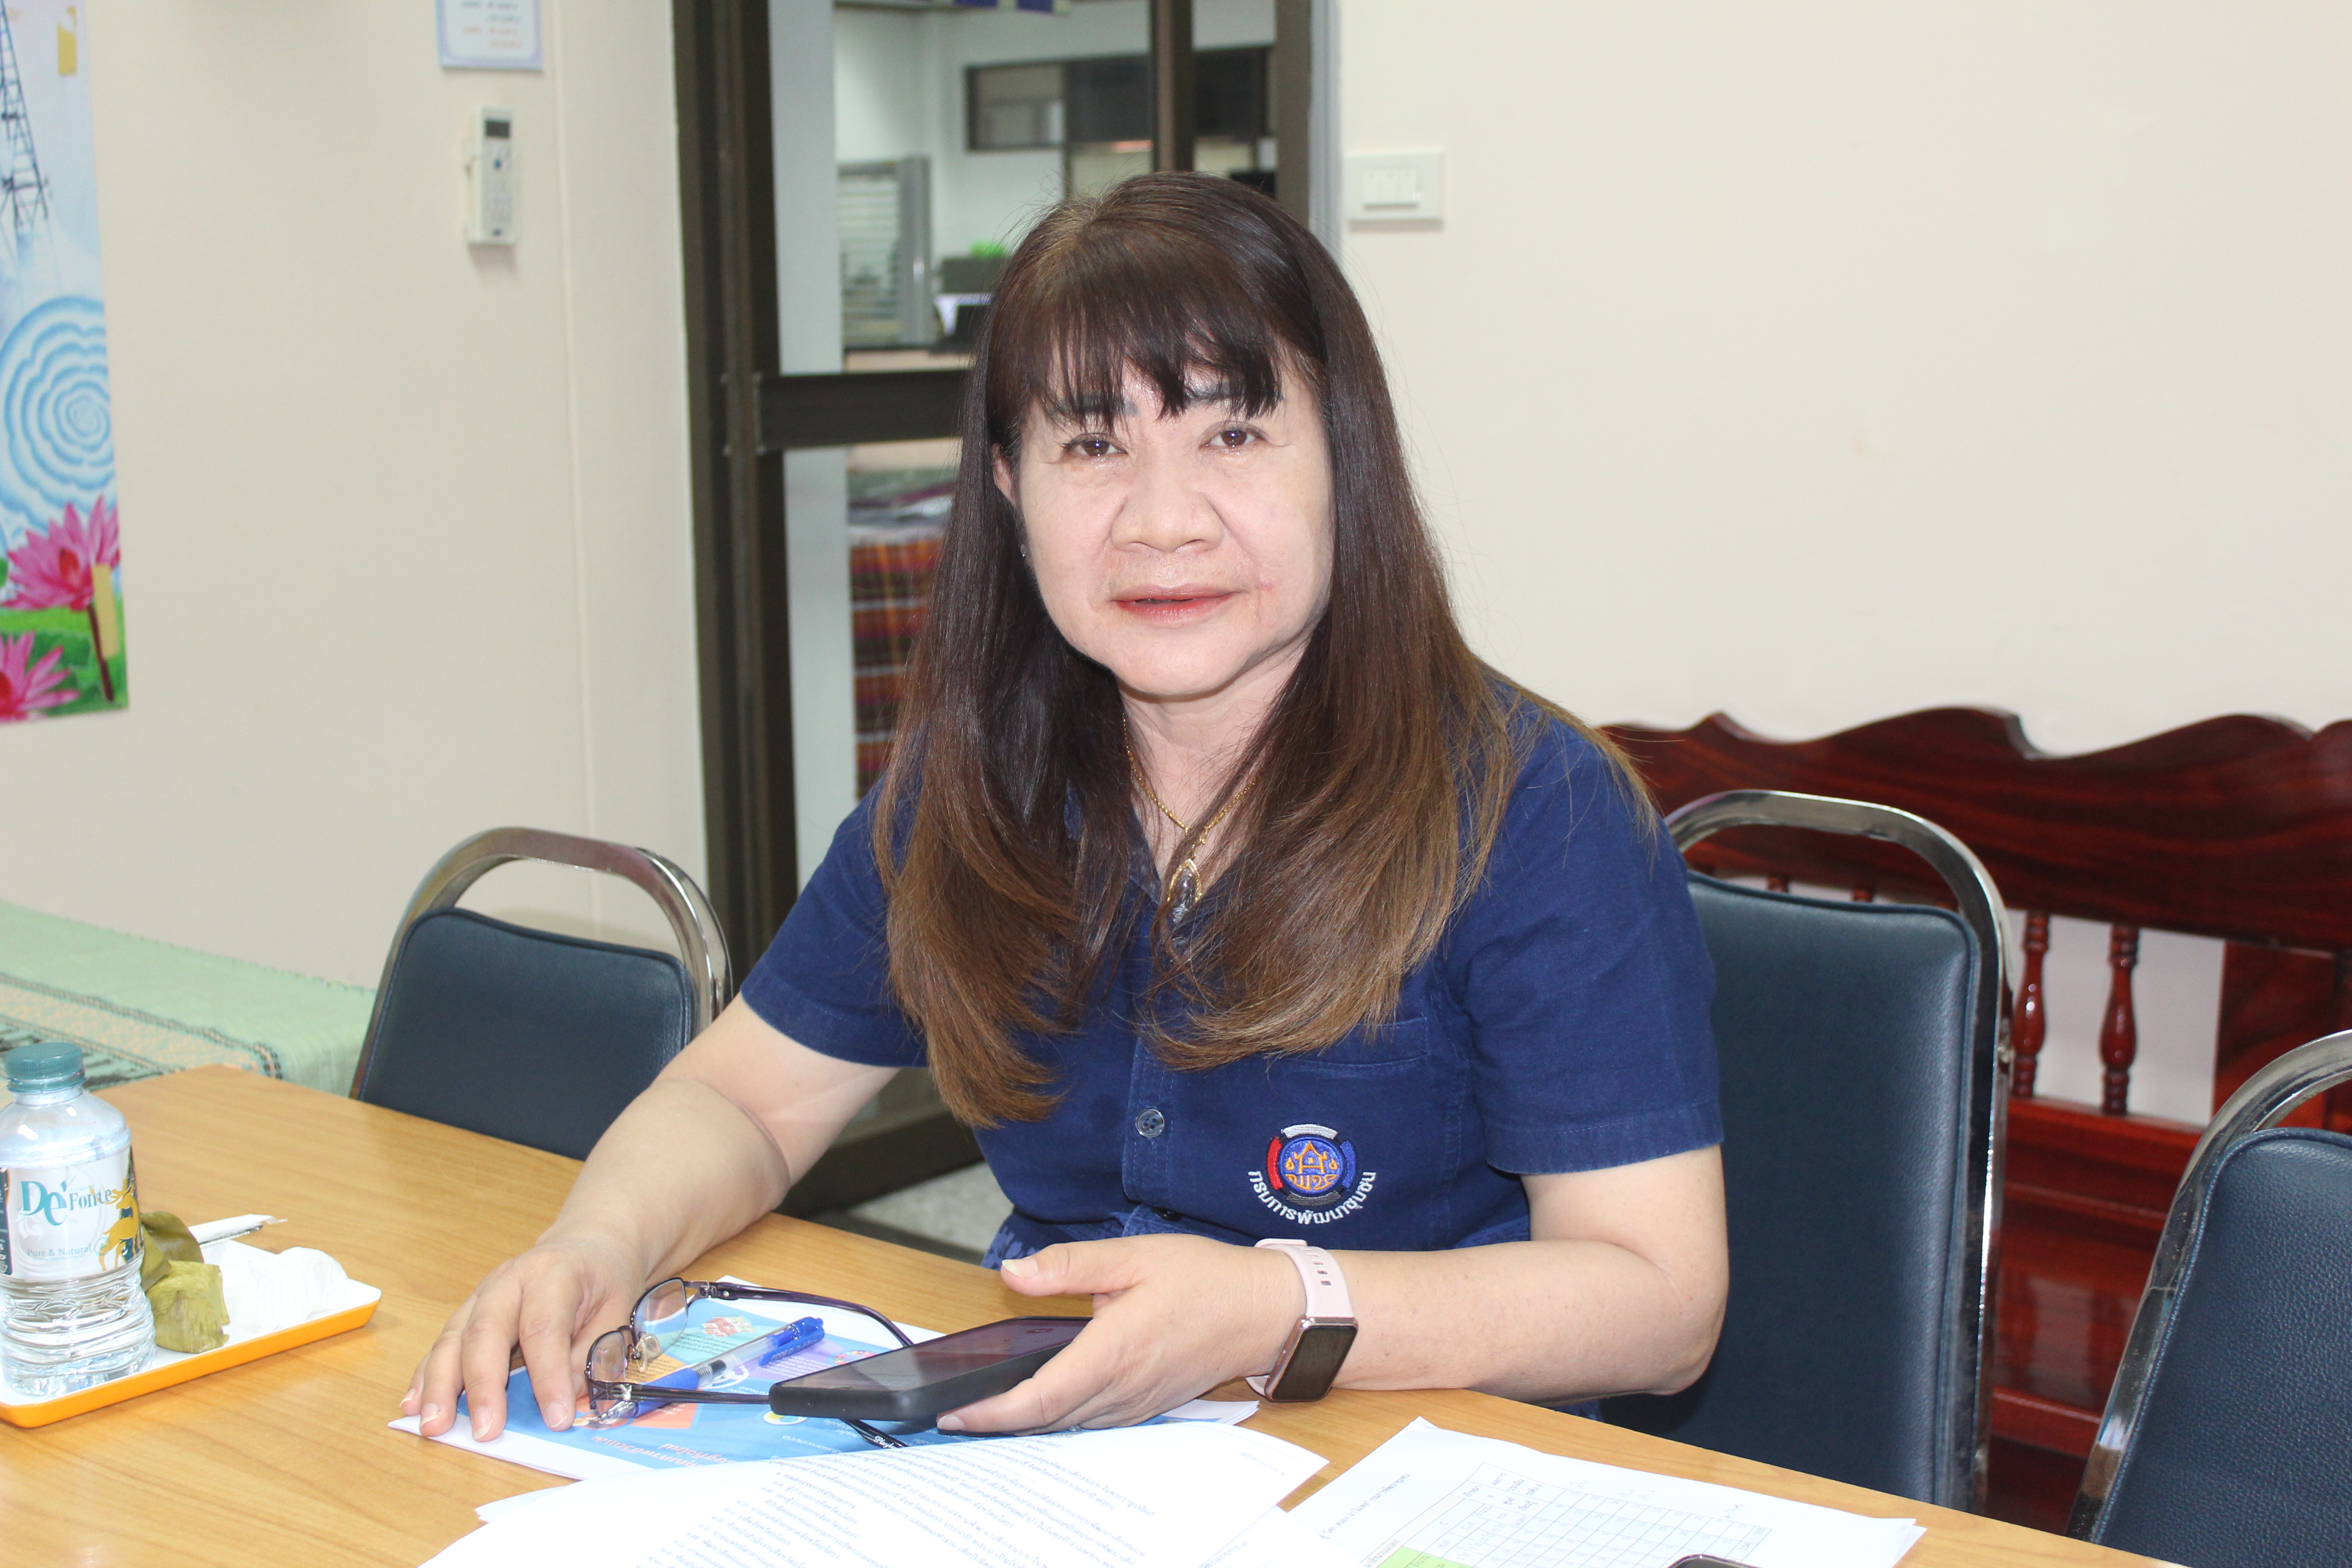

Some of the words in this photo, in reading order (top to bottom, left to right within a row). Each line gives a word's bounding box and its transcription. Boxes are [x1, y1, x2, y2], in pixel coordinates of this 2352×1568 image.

[69, 1188, 113, 1211] Fonte
[1248, 1171, 1377, 1225] กรมการพัฒนาชุมชน
[27, 1248, 47, 1257] Pure
[58, 1244, 92, 1256] Natural
